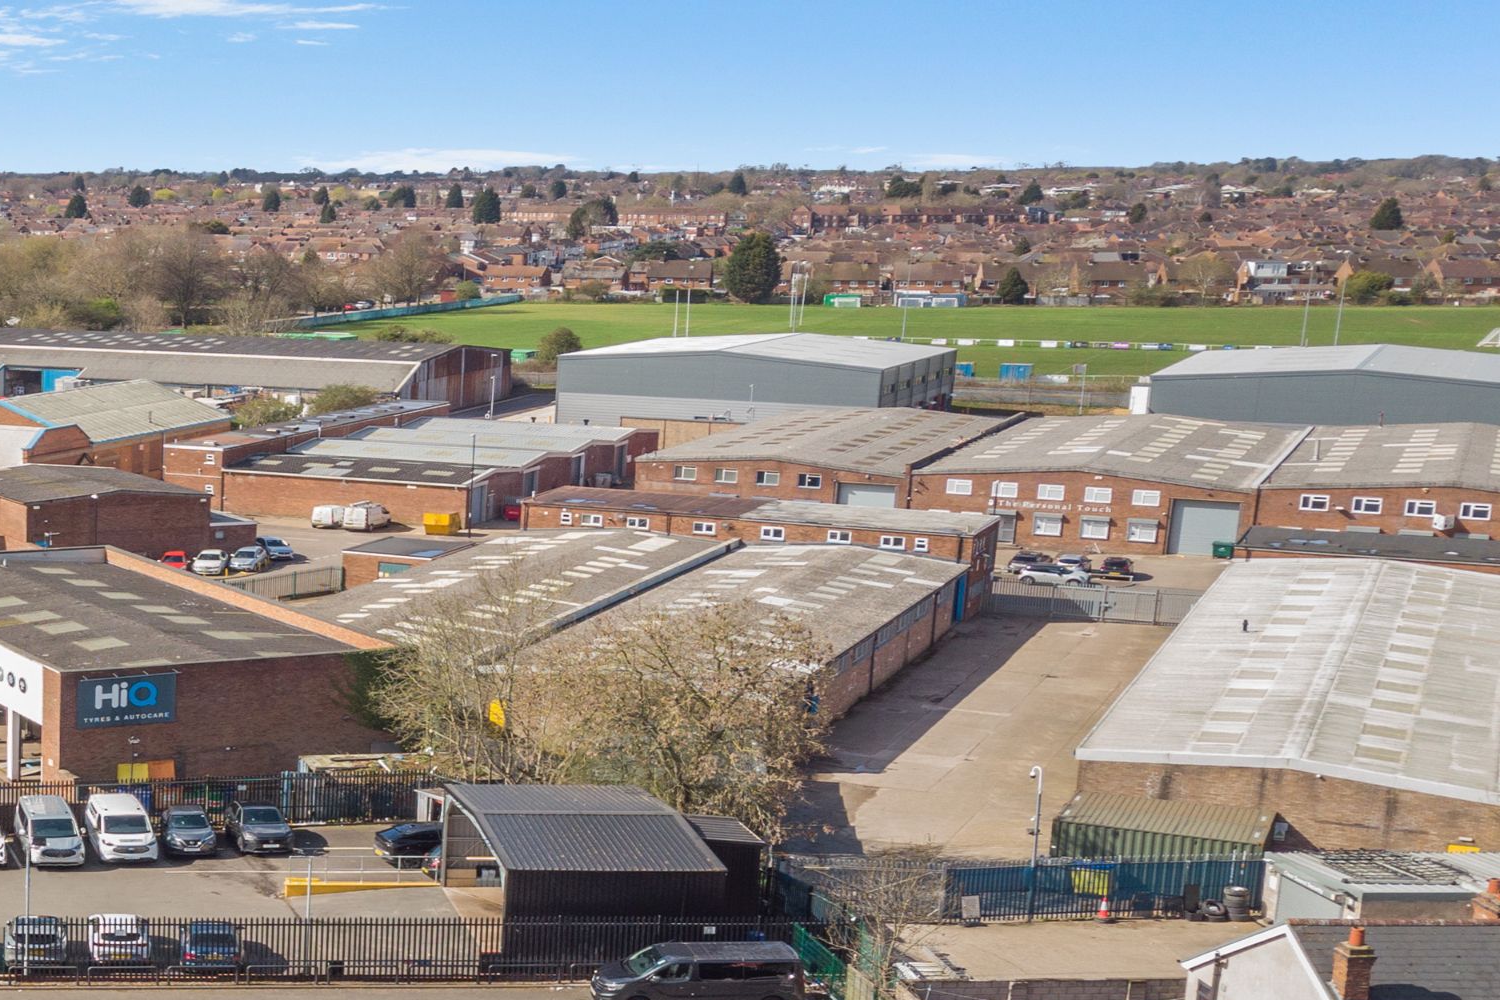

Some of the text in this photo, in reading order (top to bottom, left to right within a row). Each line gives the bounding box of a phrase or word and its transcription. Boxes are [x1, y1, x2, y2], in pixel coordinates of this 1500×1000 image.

[997, 499, 1112, 513] The Personal Touch
[94, 680, 158, 710] HiQ
[83, 711, 171, 724] TYRES & AUTOCARE
